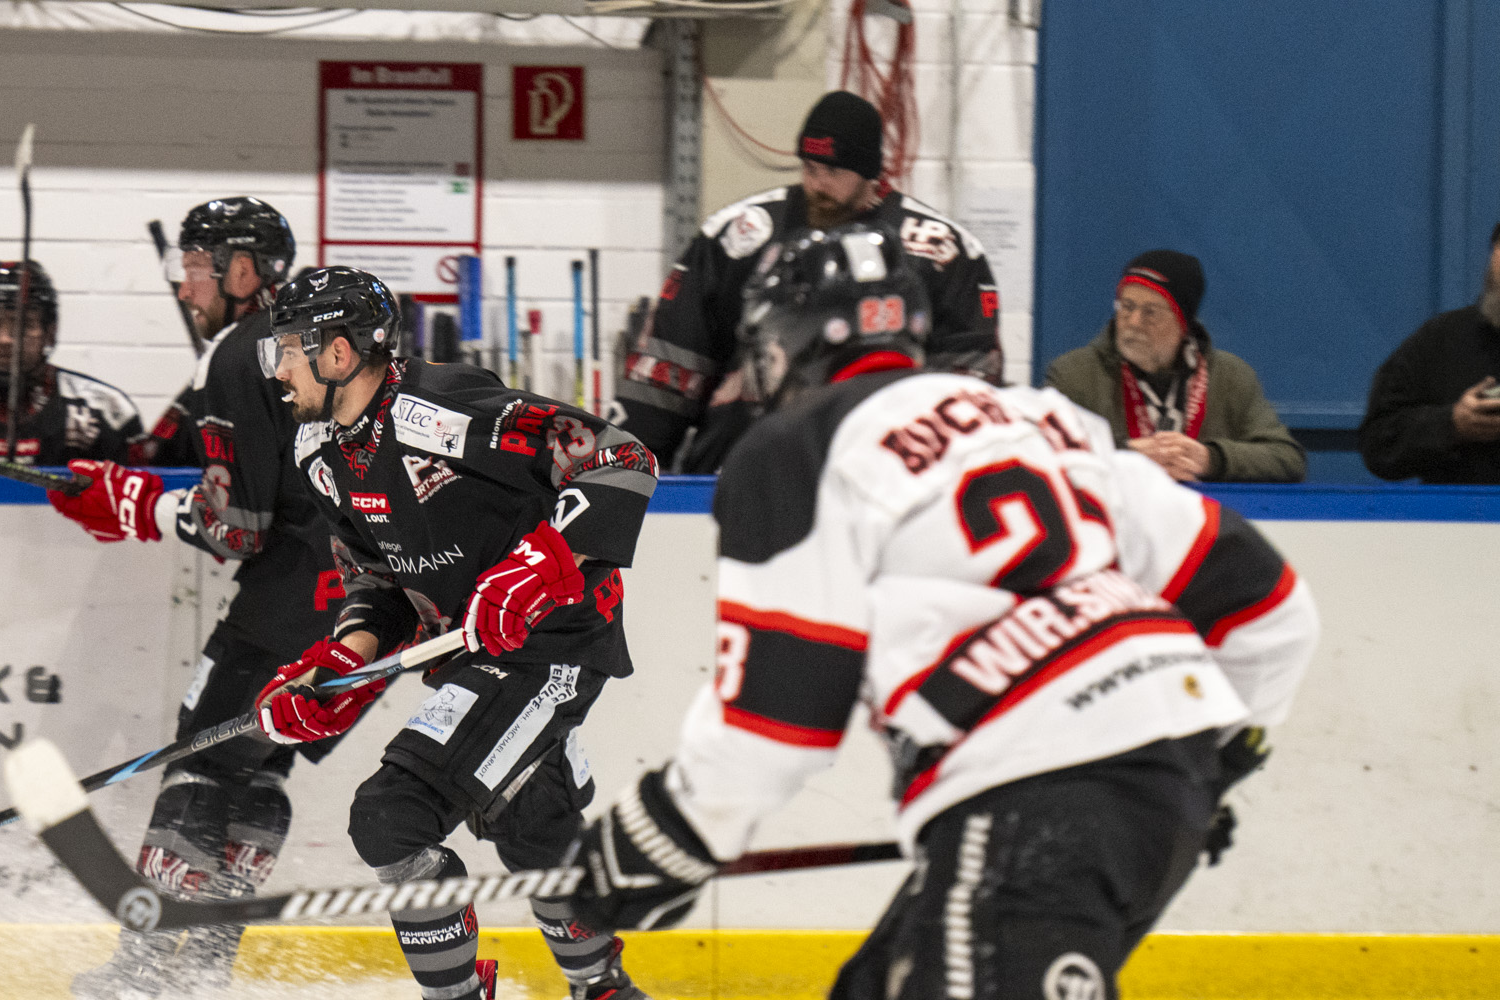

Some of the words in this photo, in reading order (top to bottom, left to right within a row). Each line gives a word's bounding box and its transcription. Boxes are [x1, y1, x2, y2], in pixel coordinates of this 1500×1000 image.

[313, 310, 344, 322] CCM
[393, 397, 439, 428] SiTec
[330, 649, 357, 668] CCM
[25, 665, 63, 704] &
[497, 724, 521, 754] MICHAEL
[478, 753, 498, 778] ARNDT
[279, 866, 586, 921] WARRIOR
[400, 921, 462, 937] FAHRSCHULE
[401, 928, 463, 945] BANNAT
